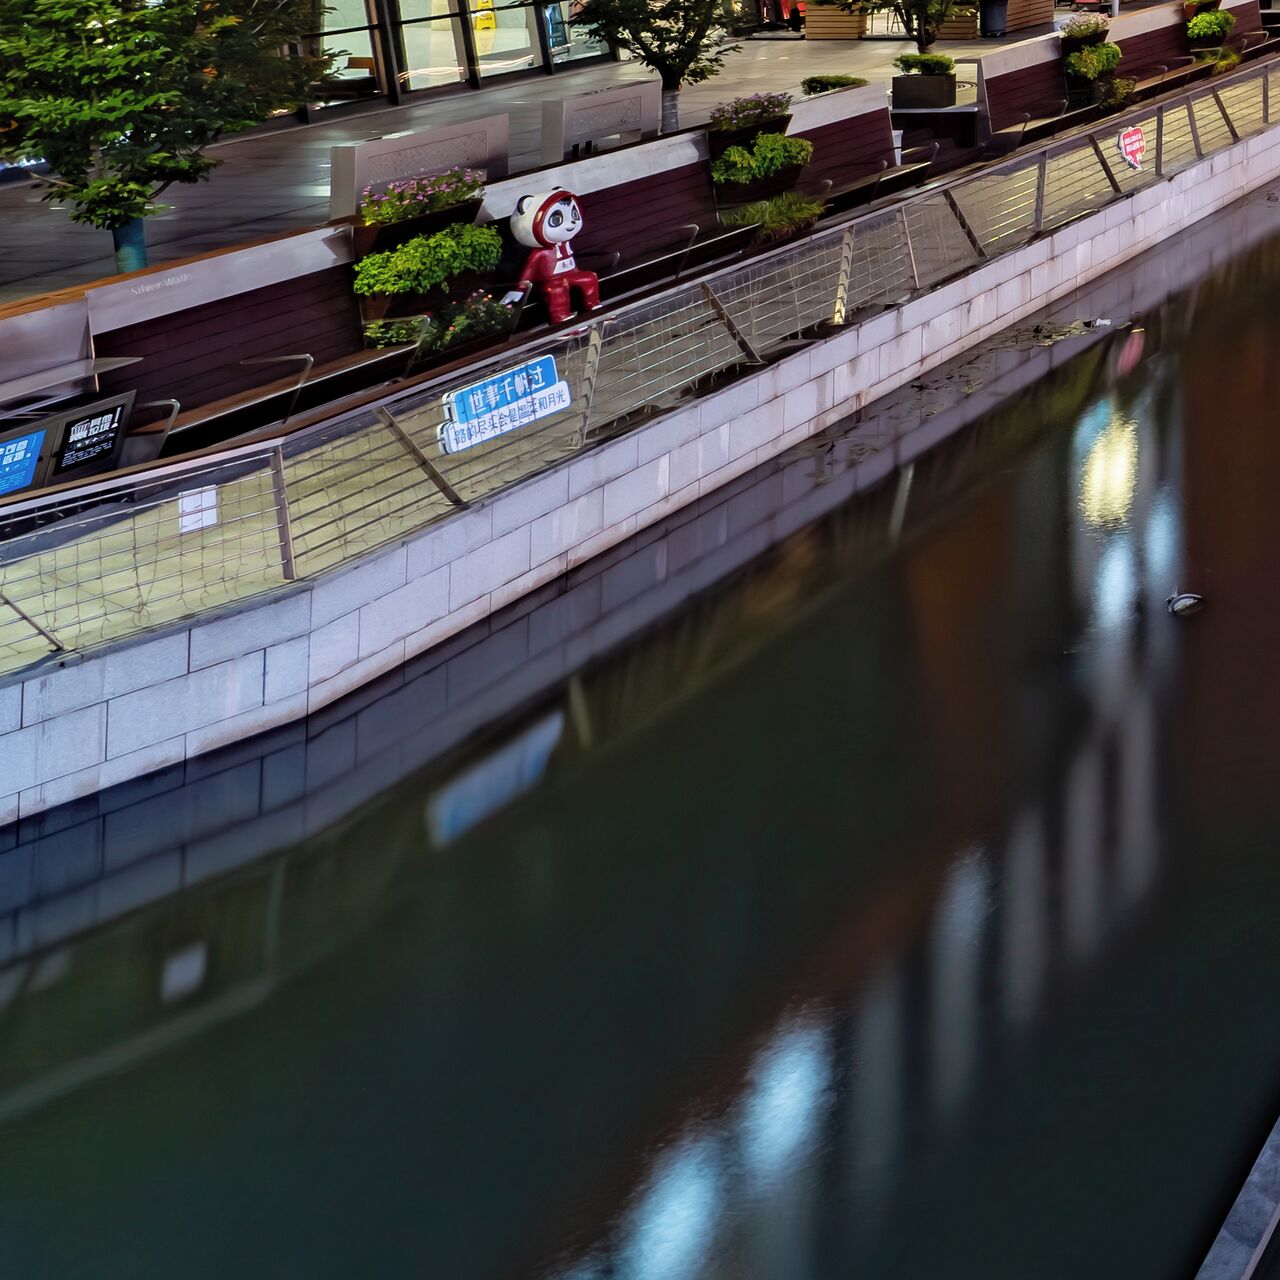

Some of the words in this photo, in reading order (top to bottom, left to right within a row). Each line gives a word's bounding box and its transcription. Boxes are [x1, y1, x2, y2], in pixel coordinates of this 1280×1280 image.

[468, 365, 546, 415] 世事千帆过
